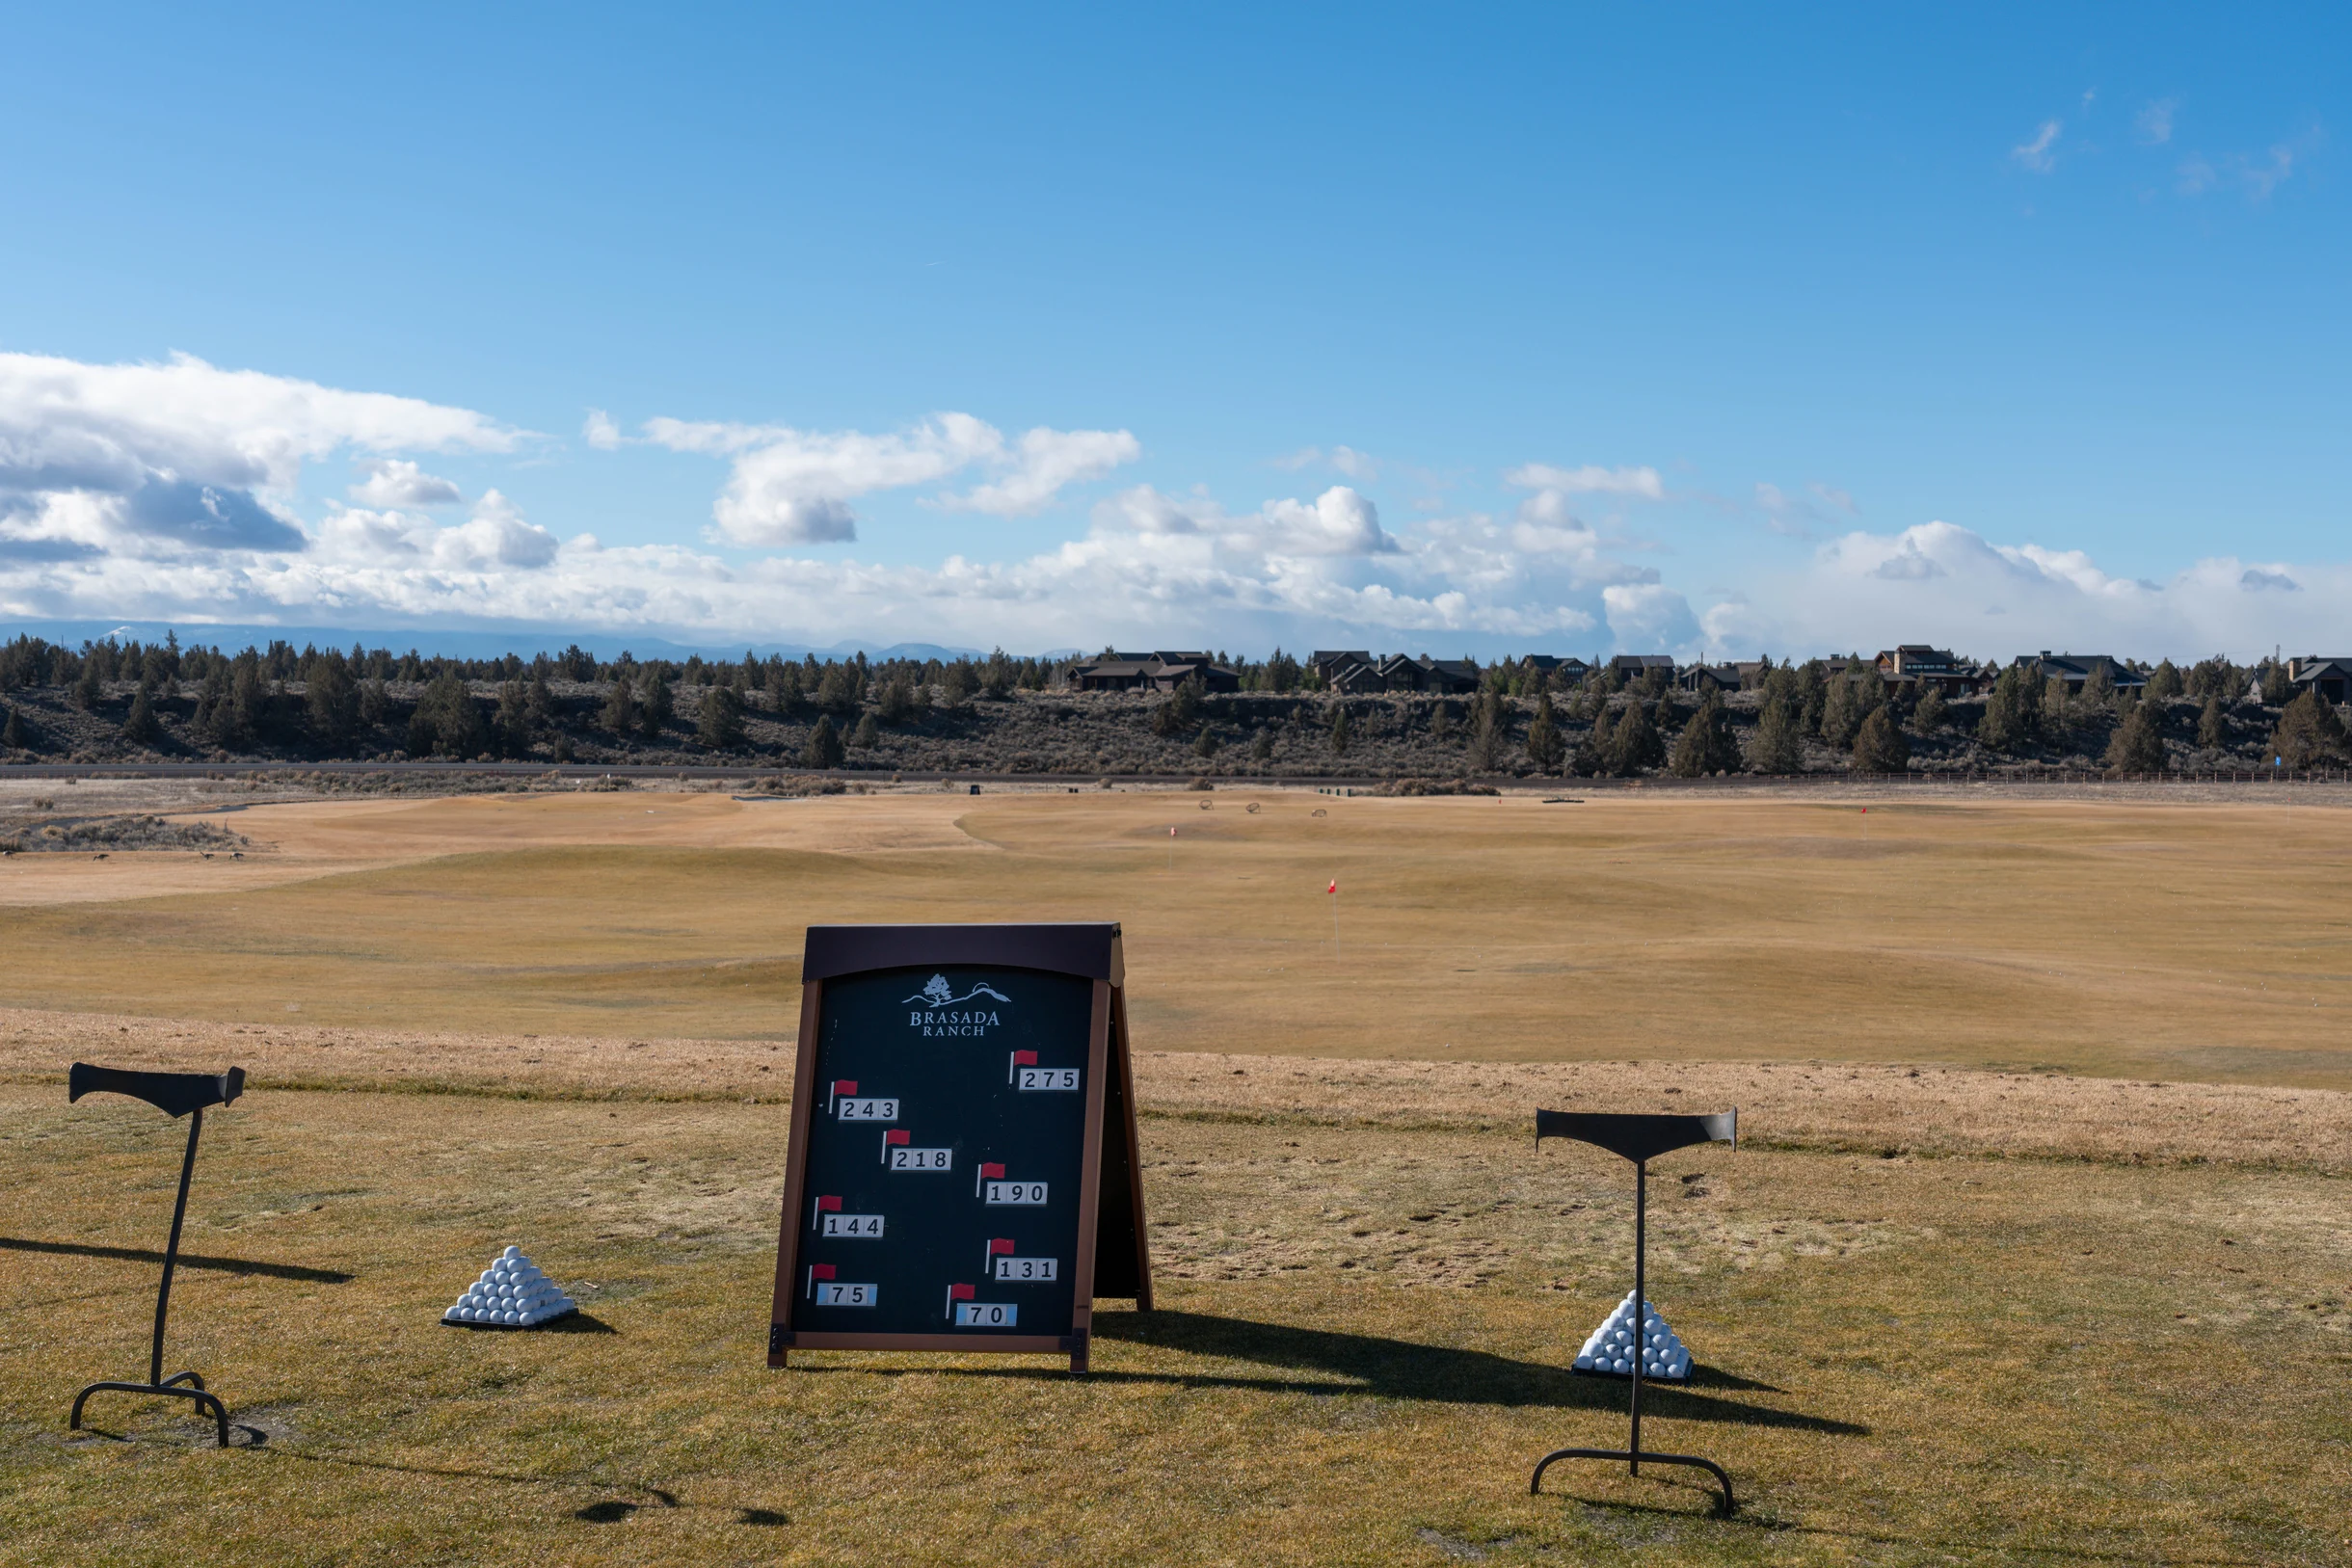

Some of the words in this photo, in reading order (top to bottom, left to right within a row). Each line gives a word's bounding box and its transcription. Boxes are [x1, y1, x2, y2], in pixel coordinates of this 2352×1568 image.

[909, 1010, 1001, 1027] BRASADA
[922, 1025, 985, 1037] RANCH
[1024, 1072, 1075, 1088] 275
[843, 1102, 895, 1118] 243
[896, 1151, 947, 1168] 218
[991, 1185, 1043, 1202] 190
[828, 1218, 879, 1235] 144
[1000, 1262, 1052, 1278] 131
[832, 1287, 864, 1303] 75
[971, 1307, 1002, 1323] 70
